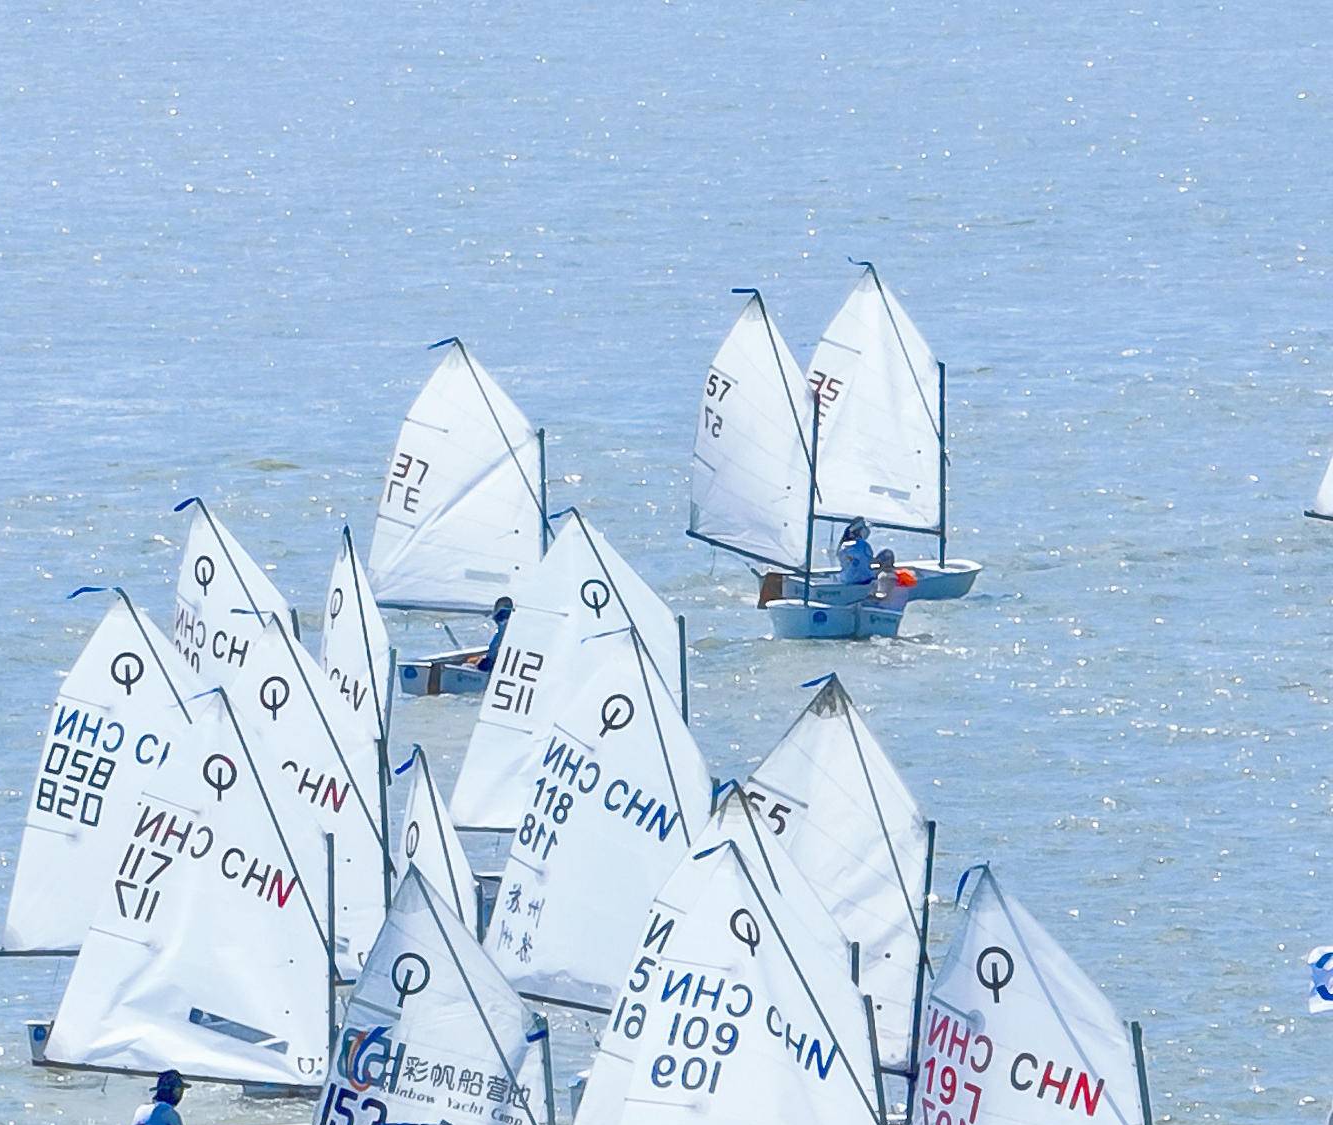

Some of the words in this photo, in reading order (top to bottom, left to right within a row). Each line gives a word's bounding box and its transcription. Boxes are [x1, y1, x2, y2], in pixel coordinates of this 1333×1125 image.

[707, 374, 732, 402] 57
[393, 453, 429, 485] 37
[212, 630, 249, 668] CH
[501, 646, 544, 682] 112
[533, 777, 573, 825] 118
[604, 780, 681, 842] CHN
[118, 843, 173, 885] 117
[221, 847, 299, 908] CHN
[668, 1012, 740, 1056] 109
[765, 1005, 837, 1081] CHN
[380, 1081, 435, 1104] Rinbow
[925, 1057, 982, 1124] 197
[1010, 1052, 1105, 1117] CHN
